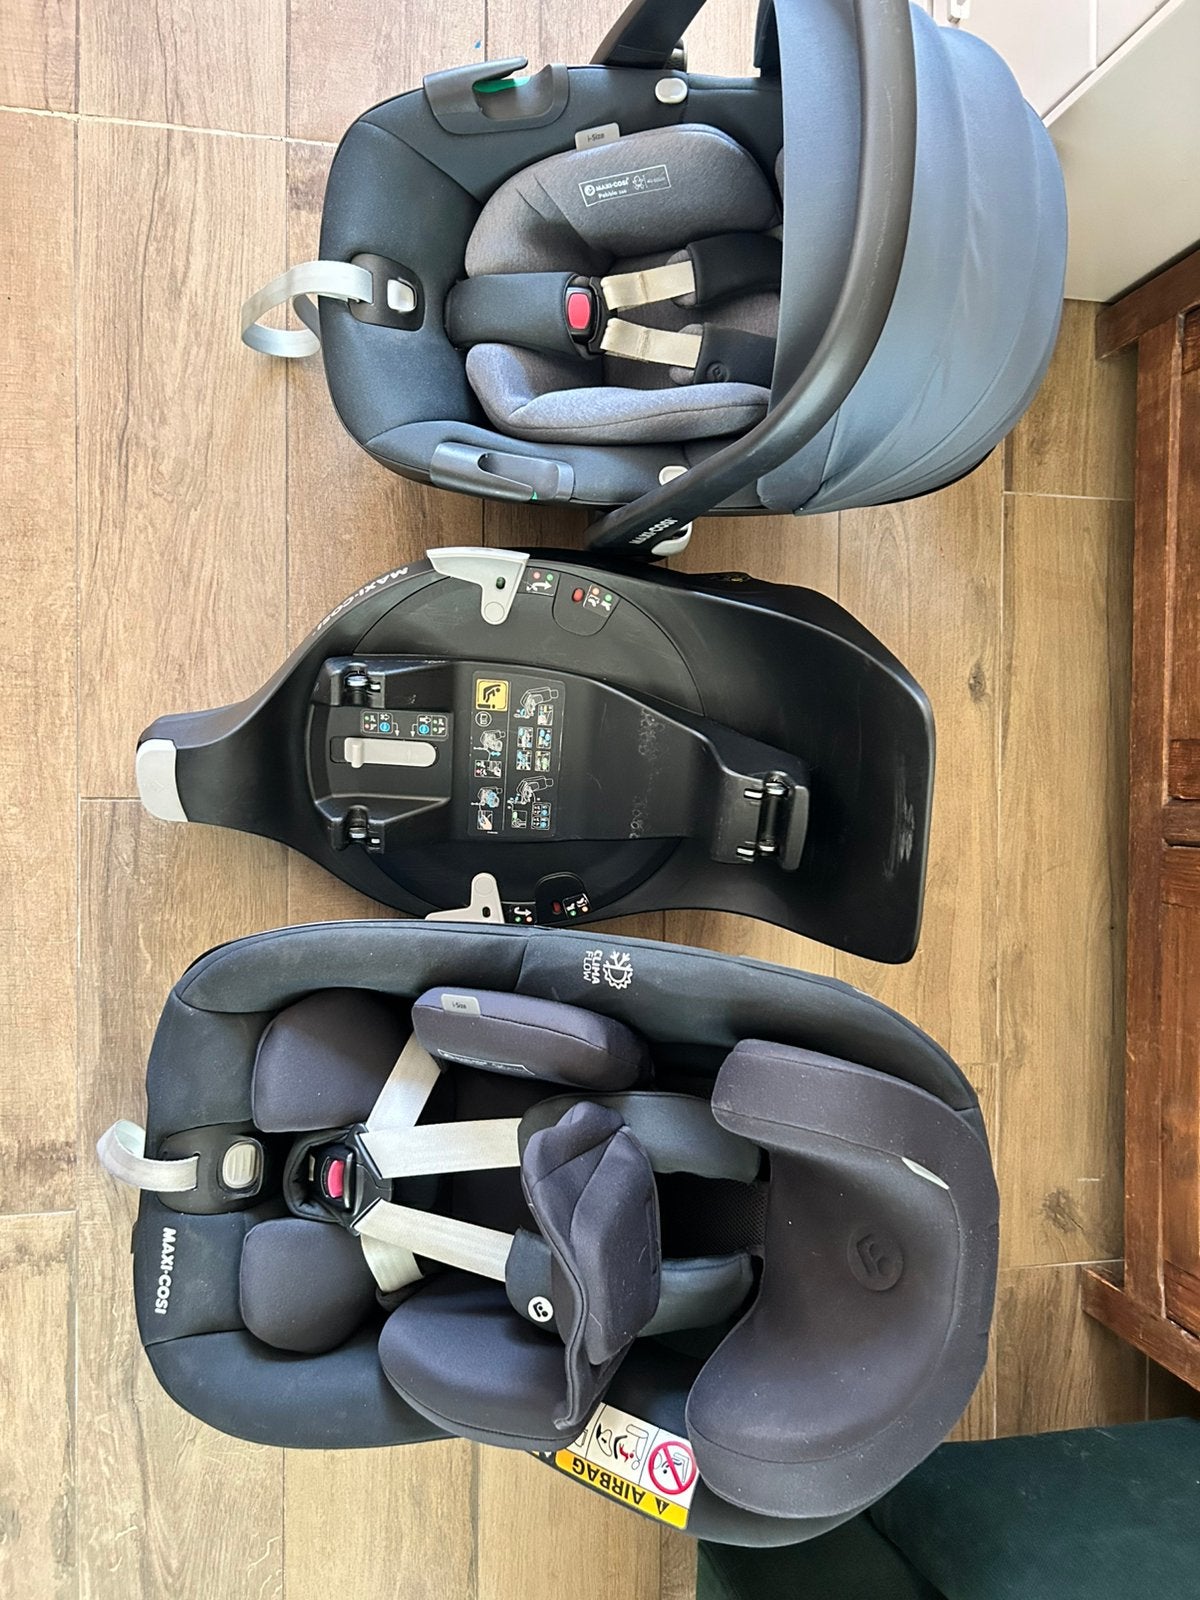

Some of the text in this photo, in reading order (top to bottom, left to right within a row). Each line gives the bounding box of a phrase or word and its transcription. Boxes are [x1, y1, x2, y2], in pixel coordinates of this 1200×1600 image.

[598, 189, 617, 198] Pebble
[583, 951, 593, 981] FLOW
[592, 950, 603, 984] CLIMA
[572, 1457, 646, 1505] AIRBAG
